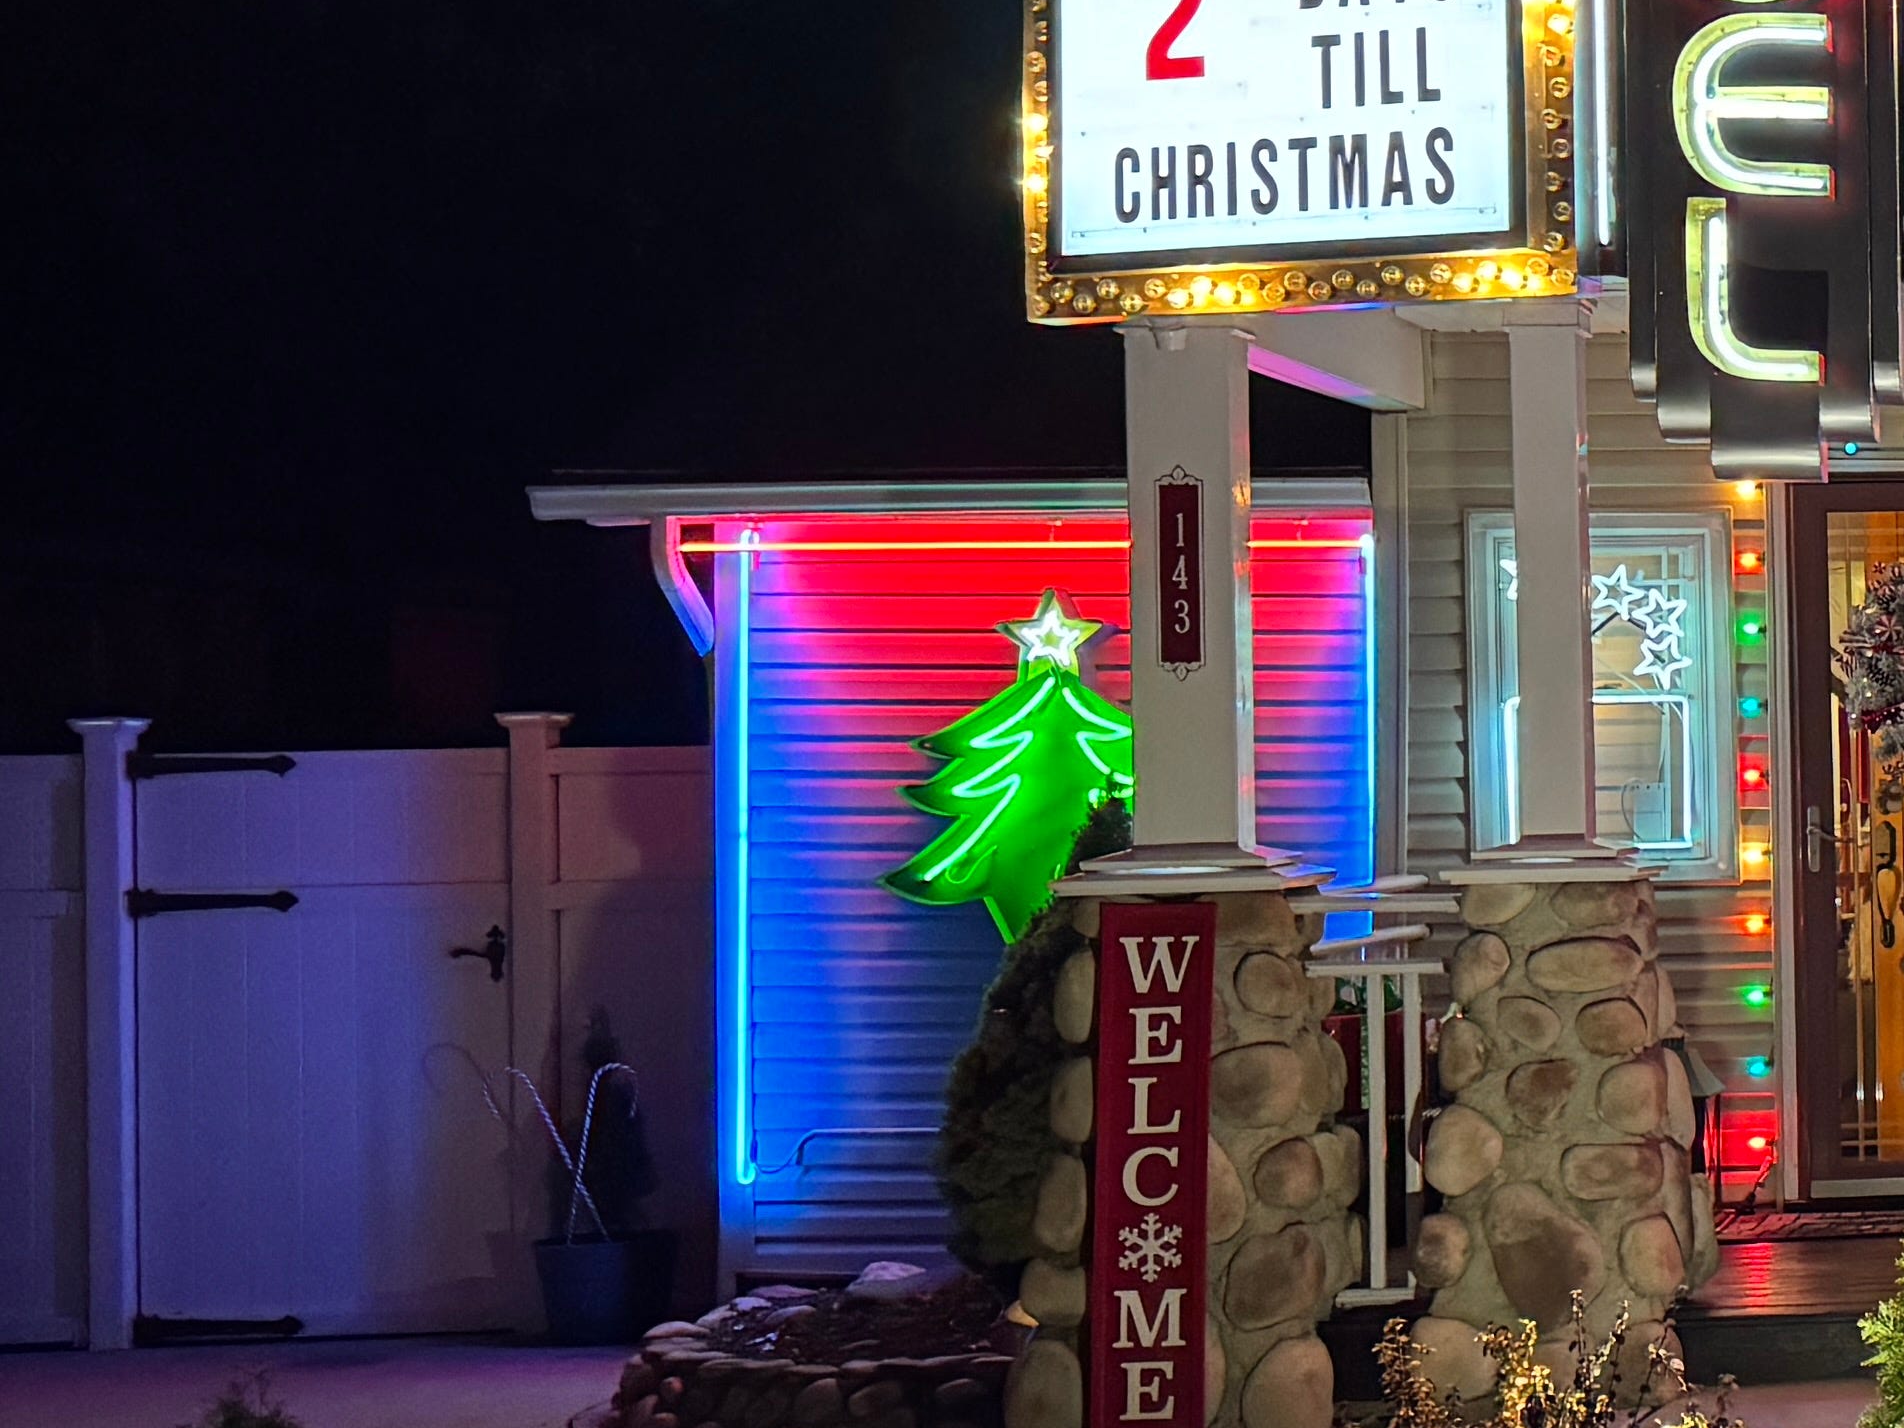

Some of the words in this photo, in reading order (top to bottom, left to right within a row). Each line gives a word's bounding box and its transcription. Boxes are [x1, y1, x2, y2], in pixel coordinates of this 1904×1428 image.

[1310, 27, 1443, 110] TILL
[1113, 127, 1457, 224] CHRISTMAS
[1172, 512, 1190, 634] 143
[1112, 935, 1200, 1422] WELCME
